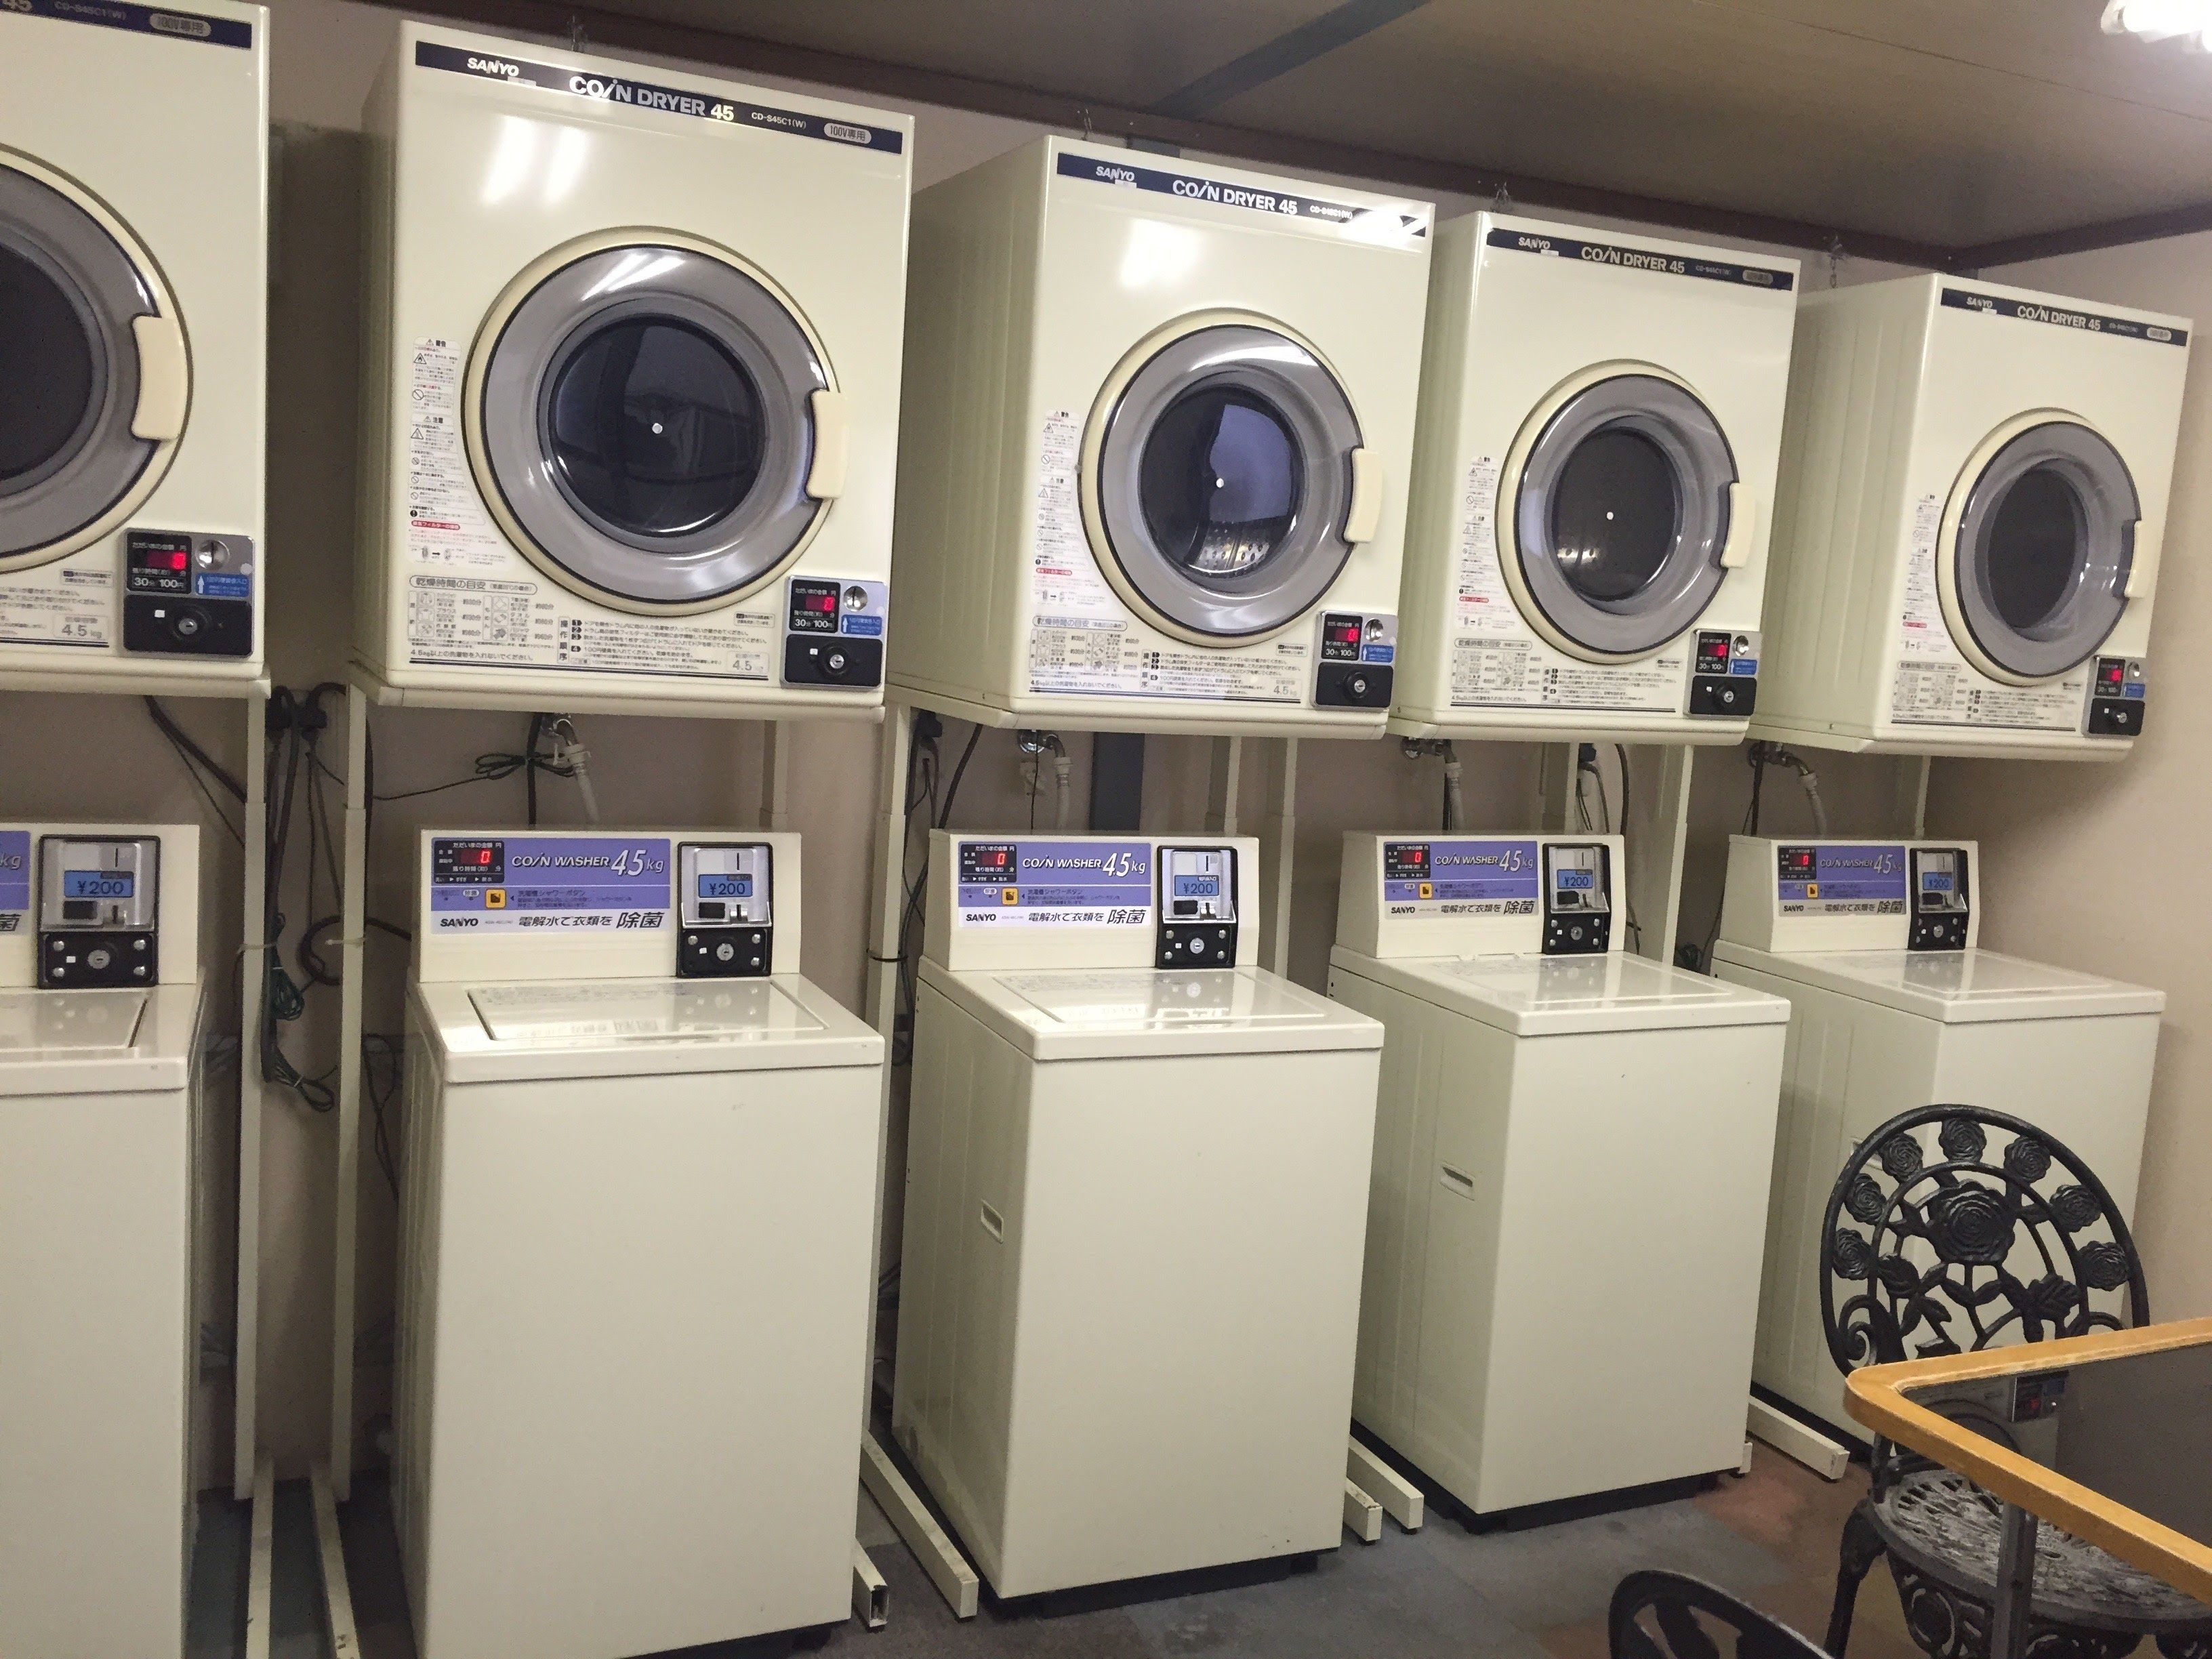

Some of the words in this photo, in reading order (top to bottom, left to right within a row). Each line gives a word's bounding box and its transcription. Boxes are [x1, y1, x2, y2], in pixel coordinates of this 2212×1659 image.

[468, 58, 519, 76] SANYO
[569, 76, 632, 102] COIN
[637, 89, 705, 116] DRYER
[711, 104, 734, 121] 45
[752, 112, 806, 129] CD-S45C1(W)
[830, 125, 865, 141] 100V専用
[1096, 166, 1134, 181] SANYO
[1172, 180, 1219, 201] COIN
[1224, 189, 1275, 211] DRYER
[1279, 199, 1297, 215] 45
[1518, 237, 1551, 249] SANYO
[1581, 246, 1620, 264] COIN
[1624, 253, 1666, 271] DRYER
[1669, 261, 1685, 274] 45
[1967, 297, 1992, 308] SANYO
[2017, 305, 2049, 322] COIN
[2051, 311, 2086, 329] DRYER
[2088, 319, 2101, 331] 45
[480, 851, 490, 863] 0
[512, 852, 550, 867] COIN
[555, 856, 609, 867] WASHER
[998, 853, 1006, 865] 0
[1023, 855, 1053, 868] COIN
[1057, 859, 1102, 868] WASHER
[1435, 853, 1460, 865] COIN
[1462, 856, 1498, 865] WASHER
[1820, 857, 1841, 867] COIN
[77, 881, 124, 895] ¥200
[710, 882, 745, 895] ¥200
[1183, 883, 1213, 894] ¥200
[1564, 876, 1589, 887] ¥200
[1503, 901, 1534, 915] 除菌
[440, 918, 479, 927] SANYO
[519, 916, 613, 926] 電解水で衣類を
[616, 912, 665, 928] 除菌
[966, 914, 996, 922] SANYO
[1028, 912, 1104, 922] 電解水で衣類を
[1107, 909, 1146, 924] 除菌
